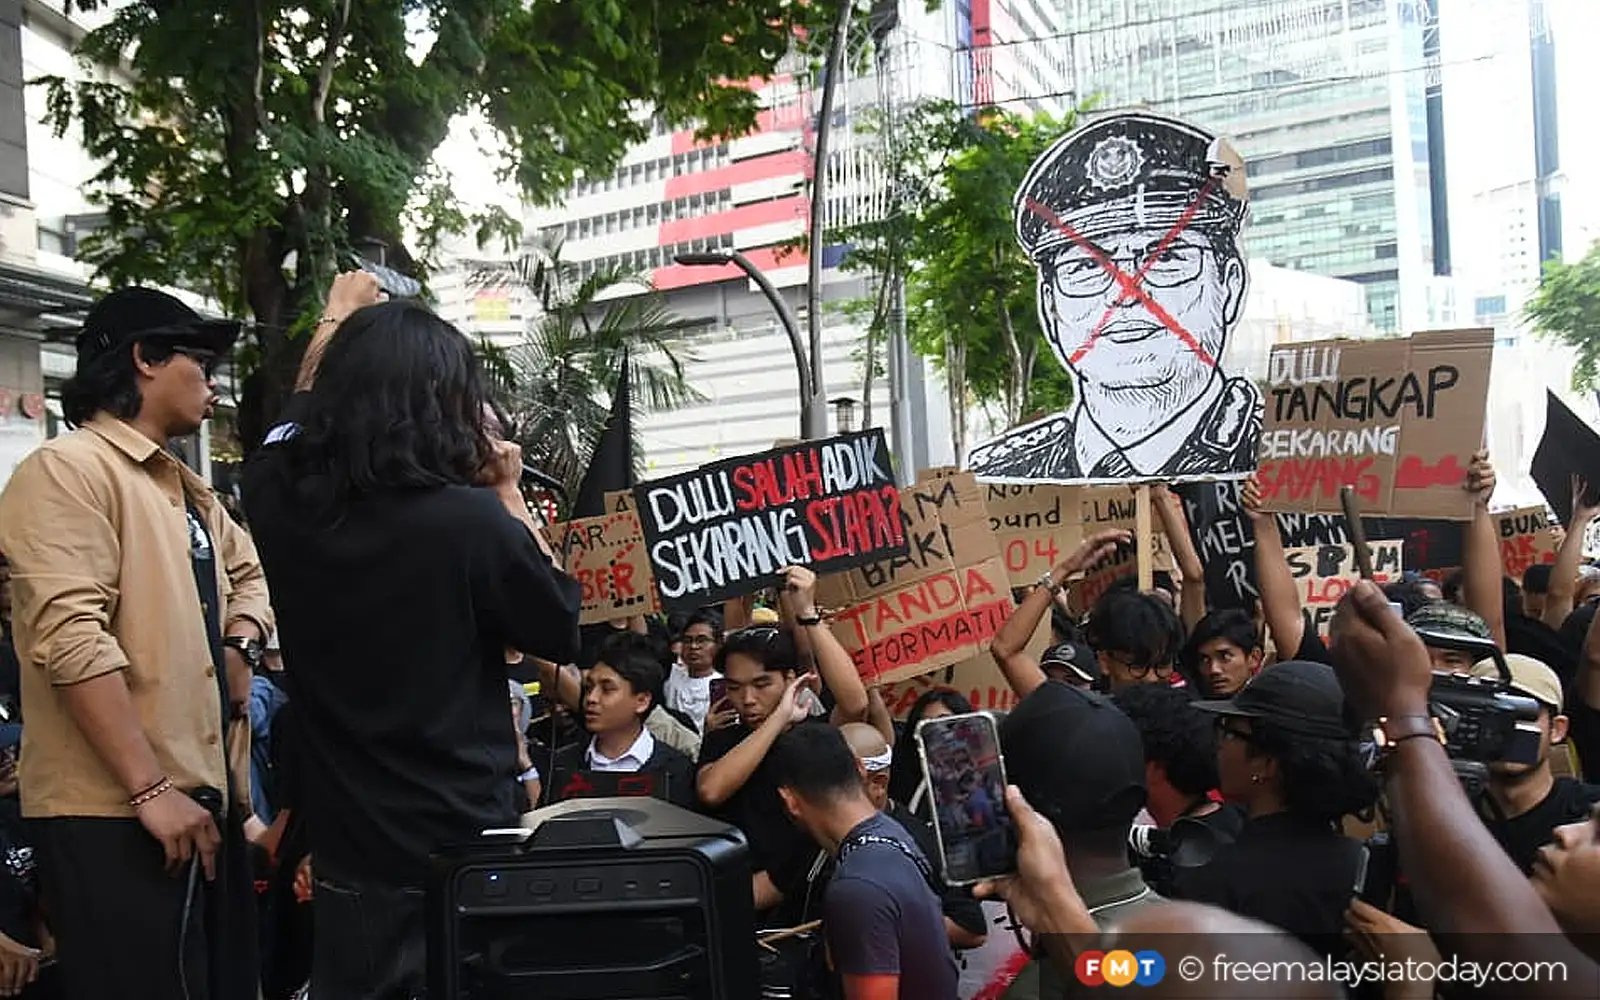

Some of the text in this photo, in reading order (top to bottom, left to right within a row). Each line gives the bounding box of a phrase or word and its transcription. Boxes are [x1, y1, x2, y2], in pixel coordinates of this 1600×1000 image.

[1269, 347, 1342, 387] DULU
[1271, 365, 1460, 422] TANGKAP
[1260, 425, 1401, 459] SEKARANG
[648, 436, 889, 534] DULU SALAH ADIK
[1256, 456, 1381, 503] SAYANG
[651, 508, 812, 599] SEKARANG
[804, 484, 904, 561] SIAPA?
[835, 568, 996, 645] TANDA
